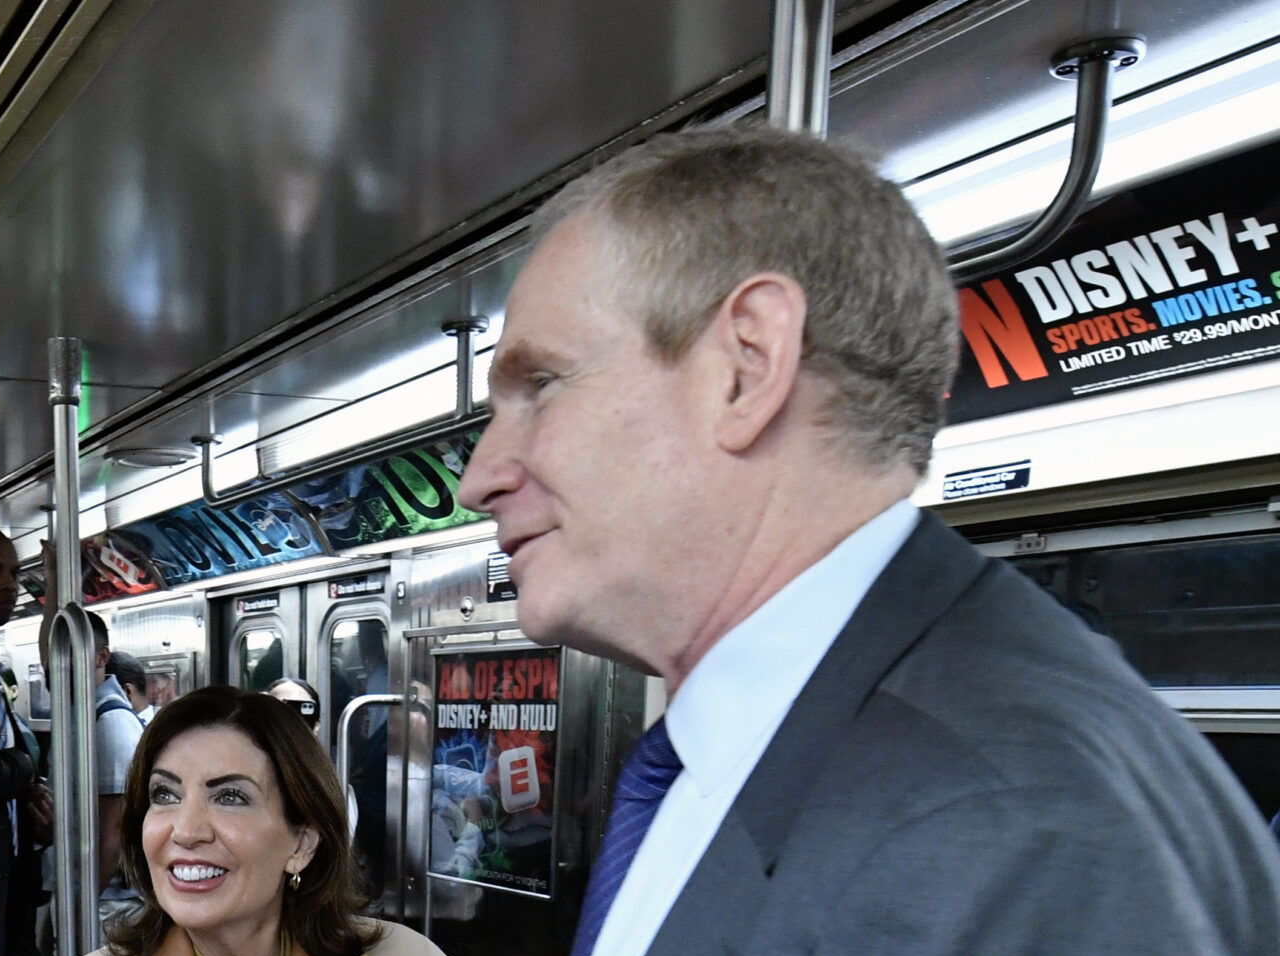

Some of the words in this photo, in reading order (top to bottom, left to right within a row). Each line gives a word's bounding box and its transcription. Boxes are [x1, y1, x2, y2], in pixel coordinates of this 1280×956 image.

[1014, 212, 1278, 324] DISNEY+
[1045, 308, 1157, 354] SPORTS.
[1152, 279, 1272, 327] MOVIES.
[1059, 346, 1127, 373] LIMITED
[1126, 335, 1173, 357] TIME
[439, 662, 471, 700] ALL
[474, 660, 498, 700] OF
[502, 658, 559, 700] ESPN
[437, 703, 488, 730] DISNEY+
[489, 703, 519, 731] AND
[520, 703, 557, 732] HULU
